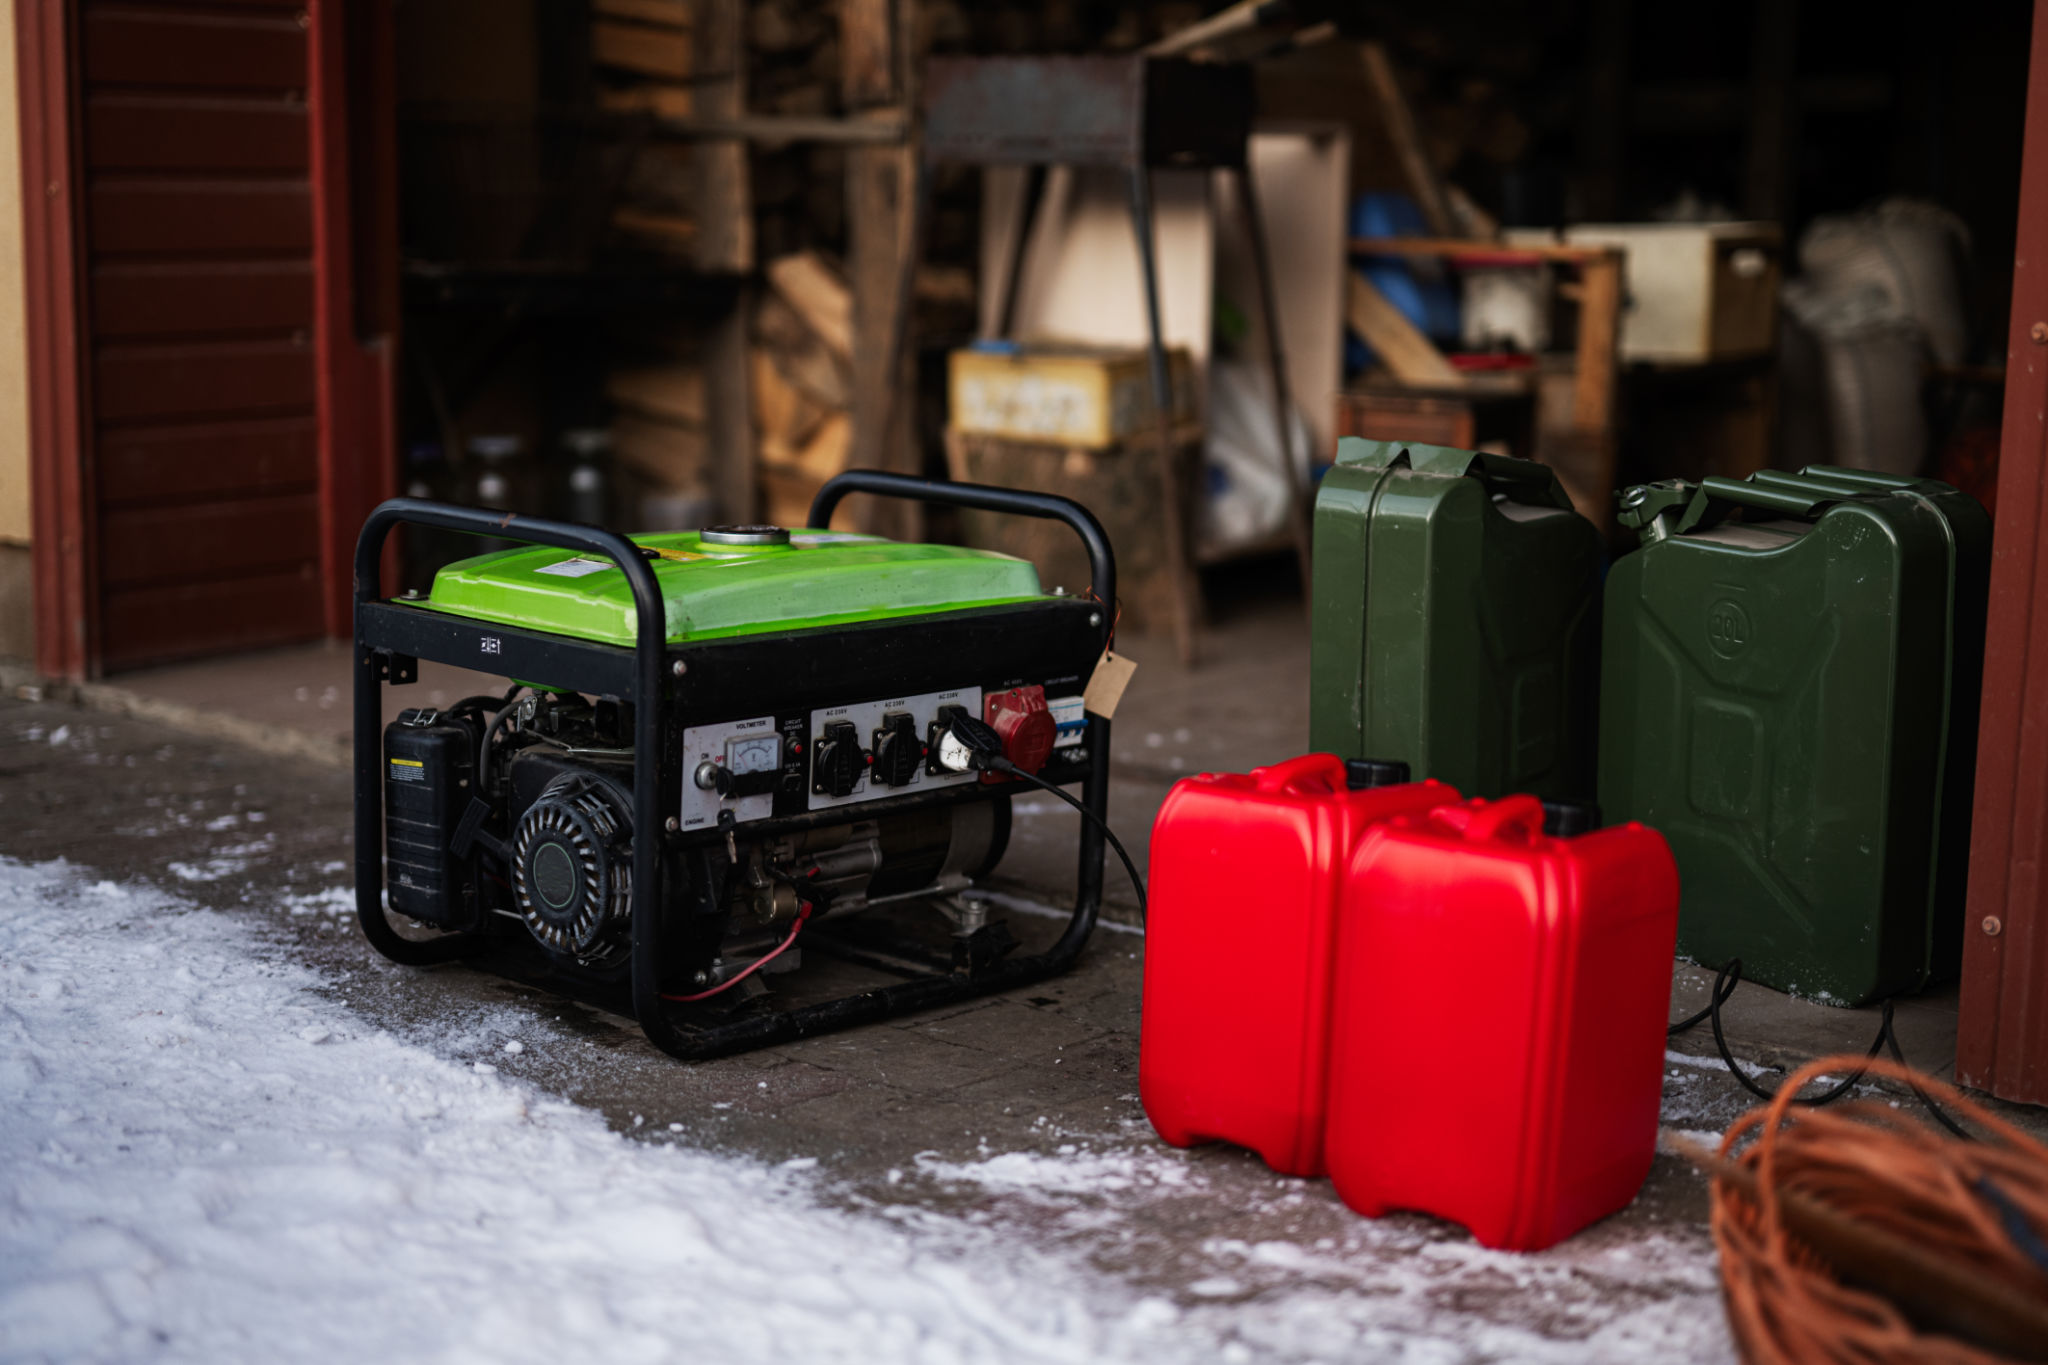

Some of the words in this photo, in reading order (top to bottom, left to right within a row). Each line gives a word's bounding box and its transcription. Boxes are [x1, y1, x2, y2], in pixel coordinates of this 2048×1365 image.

[1711, 613, 1745, 645] 20L
[736, 721, 766, 730] VOLTMETER
[701, 752, 709, 760] ON
[685, 818, 704, 826] ENGINE
